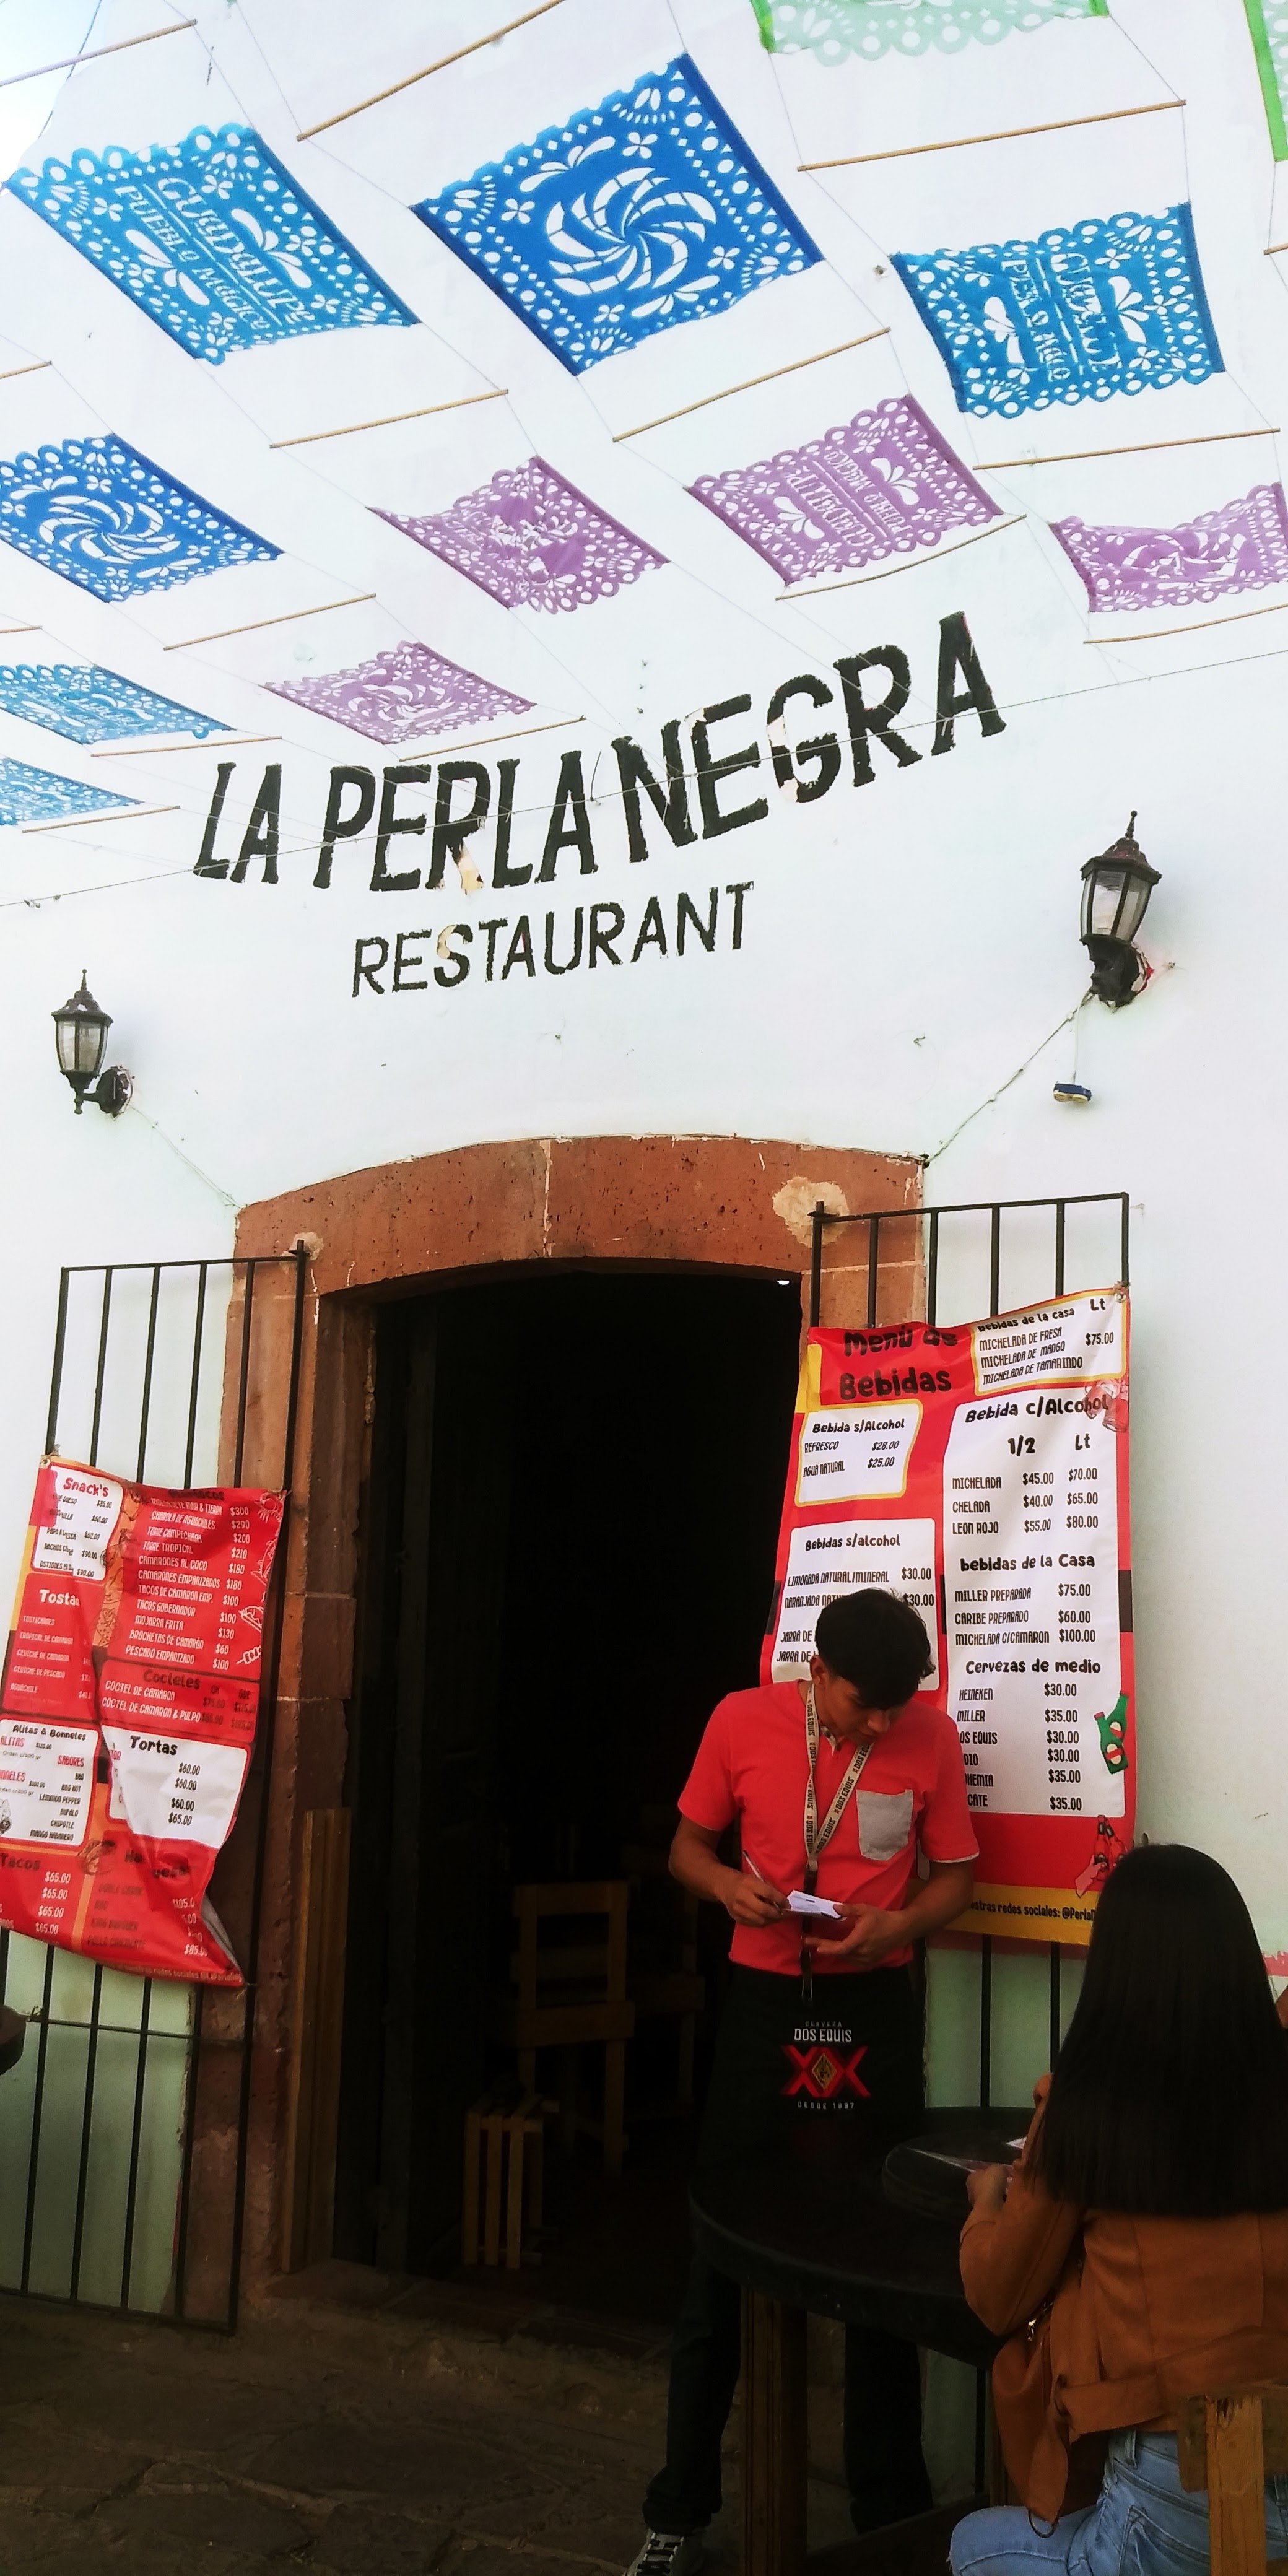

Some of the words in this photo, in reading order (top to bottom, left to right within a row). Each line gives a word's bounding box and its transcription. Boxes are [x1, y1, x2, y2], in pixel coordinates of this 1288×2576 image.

[193, 762, 282, 883] LA
[313, 751, 599, 894] PERLA
[611, 611, 1006, 863] NEGRA
[352, 881, 754, 997] RESTAURANT
[1090, 1298, 1106, 1311] Lt
[977, 1318, 1019, 1332] Bebidas
[1022, 1315, 1035, 1325] de
[1038, 1313, 1049, 1322] la
[1052, 1308, 1075, 1320] casa
[980, 1336, 1027, 1351] MICHELADA
[1029, 1332, 1038, 1344] DE
[1040, 1326, 1062, 1342] FRESA
[1086, 1331, 1114, 1346] $75.00
[981, 1352, 1025, 1368] MICHELADA
[1027, 1349, 1037, 1361] DE
[1040, 1341, 1066, 1357] MANGO
[983, 1366, 1024, 1385] MICHELADA
[1025, 1364, 1034, 1375] DE
[1036, 1356, 1082, 1372] TAMARINDO
[840, 1367, 952, 1400] Bebidas
[965, 1402, 1019, 1423] Bebida
[1025, 1395, 1108, 1417] c/Alcohol
[812, 1422, 850, 1433] Bebida
[854, 1418, 905, 1433] s/Alcohol
[804, 1441, 839, 1453] REFRESCO
[871, 1440, 900, 1451] $28.00
[1007, 1435, 1035, 1456] 1/2
[1075, 1433, 1090, 1451] Lt
[803, 1464, 819, 1477] AGUA
[820, 1460, 845, 1475] NATURAL
[868, 1456, 895, 1469] $25.00
[63, 1477, 108, 1497] Snack's
[952, 1476, 1002, 1489] MICHELADA
[1022, 1472, 1054, 1486] $45.00
[1068, 1468, 1097, 1481] $70.00
[952, 1500, 990, 1513] CHELADA
[1023, 1494, 1053, 1508] $40.00
[1067, 1492, 1098, 1505] $65.00
[230, 1507, 249, 1516] $300
[231, 1520, 250, 1530] $290
[952, 1521, 974, 1534] LEON
[976, 1521, 999, 1534] ROJO
[1024, 1518, 1051, 1533] $55.00
[1066, 1515, 1099, 1529] $80.00
[233, 1533, 250, 1544] $200
[805, 1537, 842, 1551] Bebidas
[846, 1533, 900, 1548] s/alcohol
[162, 1543, 193, 1554] TROPICAL
[231, 1547, 248, 1559] $210
[138, 1556, 179, 1567] CAMARONES
[180, 1559, 188, 1569] AL
[189, 1560, 207, 1571] COCO
[228, 1563, 245, 1573] $180
[960, 1557, 1017, 1572] bebidas
[1022, 1556, 1036, 1569] de
[1040, 1554, 1053, 1567] la
[1058, 1553, 1095, 1567] Casa
[76, 1569, 94, 1578] $90.00
[138, 1570, 177, 1583] CAMARONES
[178, 1574, 221, 1588] EMPANIZADOS
[226, 1578, 242, 1590] $180
[787, 1573, 820, 1586] LIMONADA
[820, 1570, 890, 1583] NATURAL/MINERAL
[902, 1567, 931, 1580] $30.00
[138, 1585, 159, 1595] TACOS
[159, 1586, 168, 1596] DE
[168, 1588, 198, 1601] CAMARON
[199, 1593, 214, 1603] EMP.
[222, 1595, 239, 1606] $100
[955, 1590, 988, 1602] MILLER
[991, 1587, 1031, 1601] PREPARADA
[1058, 1583, 1090, 1597] $75.00
[785, 1595, 820, 1608] NARANJADA
[137, 1599, 156, 1611] TACOS
[157, 1602, 196, 1617] GOBERNADOR
[220, 1612, 237, 1624] $100
[955, 1612, 986, 1625] CARIBE
[988, 1610, 1029, 1624] PREPARADO
[1058, 1609, 1090, 1624] $60.00
[134, 1615, 164, 1628] MOJARRA
[165, 1619, 184, 1631] FRITA
[218, 1627, 235, 1639] $130
[129, 1629, 165, 1644] BROCHETAS
[166, 1635, 174, 1645] DE
[215, 1643, 229, 1655] $60
[781, 1630, 801, 1643] JARRA
[803, 1630, 812, 1642] DE
[955, 1632, 1000, 1645] MICHELADA
[1001, 1630, 1049, 1644] C/CAMARON
[1059, 1629, 1095, 1642] $100.00
[126, 1645, 155, 1659] PESCADO
[155, 1650, 194, 1664] EMPANIZADO
[212, 1658, 229, 1670] $100
[777, 1651, 799, 1662] JARRA
[801, 1651, 811, 1662] DE
[965, 1660, 1026, 1674] Cervezas
[1031, 1658, 1050, 1673] de
[1055, 1659, 1101, 1673] medio
[143, 1669, 201, 1689] Cocteles
[105, 1680, 131, 1694] COCTEL
[133, 1684, 143, 1696] DE
[144, 1687, 175, 1701] CAMARON
[959, 1687, 993, 1701] HEINEKEN
[1044, 1683, 1077, 1697] $30.00
[102, 1697, 127, 1710] COCTEL
[129, 1702, 137, 1713] DE
[139, 1704, 172, 1718] CAMARON
[173, 1708, 178, 1718] &
[180, 1710, 201, 1722] PULPO
[957, 1710, 985, 1722] MILLER
[1045, 1710, 1077, 1723] $35.00
[12, 1724, 38, 1734] Alitas
[50, 1729, 86, 1741] Bonneles
[972, 1731, 998, 1744] EQUIS
[1046, 1730, 1079, 1744] $30.00
[130, 1735, 178, 1756] Tortas
[57, 1755, 84, 1767] SABORES
[1047, 1749, 1079, 1763] $30.00
[178, 1762, 200, 1775] $60.00
[1048, 1769, 1081, 1783] $35.00
[175, 1778, 196, 1791] $60.00
[171, 1798, 194, 1811] $60.00
[1050, 1797, 1082, 1811] $35.00
[168, 1812, 193, 1825] $65.00
[1, 1853, 40, 1871] Tacos
[45, 1871, 71, 1884] $65.00
[42, 1887, 68, 1900] $65.00
[38, 1905, 64, 1918] $65.00
[998, 1901, 1022, 1914] redes
[1024, 1902, 1060, 1918] sociales:
[35, 1922, 59, 1934] $65.00
[794, 2028, 816, 2042] DOS
[819, 2029, 852, 2042] EQUIS
[798, 2101, 827, 2109] DESDE
